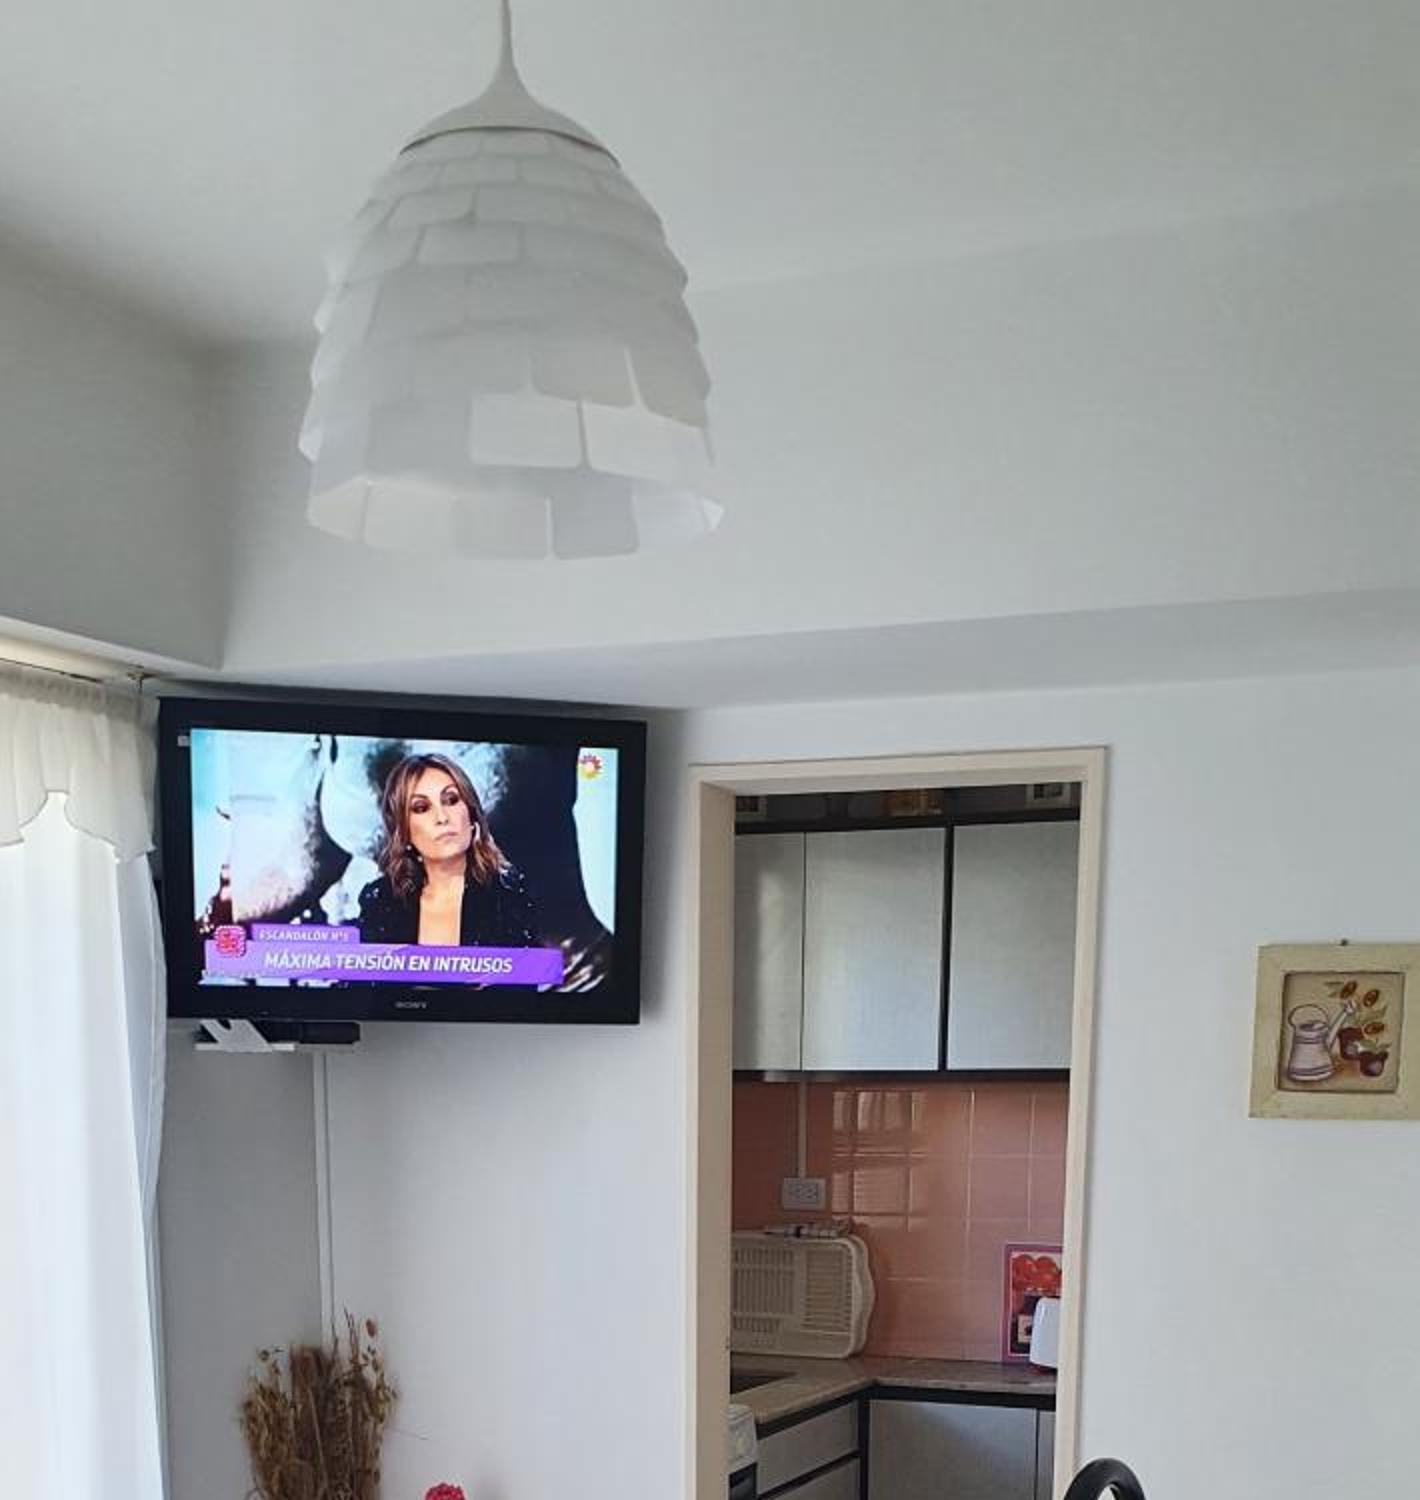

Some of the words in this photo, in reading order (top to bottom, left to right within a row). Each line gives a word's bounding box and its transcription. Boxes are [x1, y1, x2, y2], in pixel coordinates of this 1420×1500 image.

[259, 929, 328, 941] ESCANDALÓN
[264, 949, 331, 969] MÁXIMA
[336, 951, 406, 971] TENSIÓN
[408, 956, 430, 971] EN
[433, 956, 513, 973] INTRUSOS
